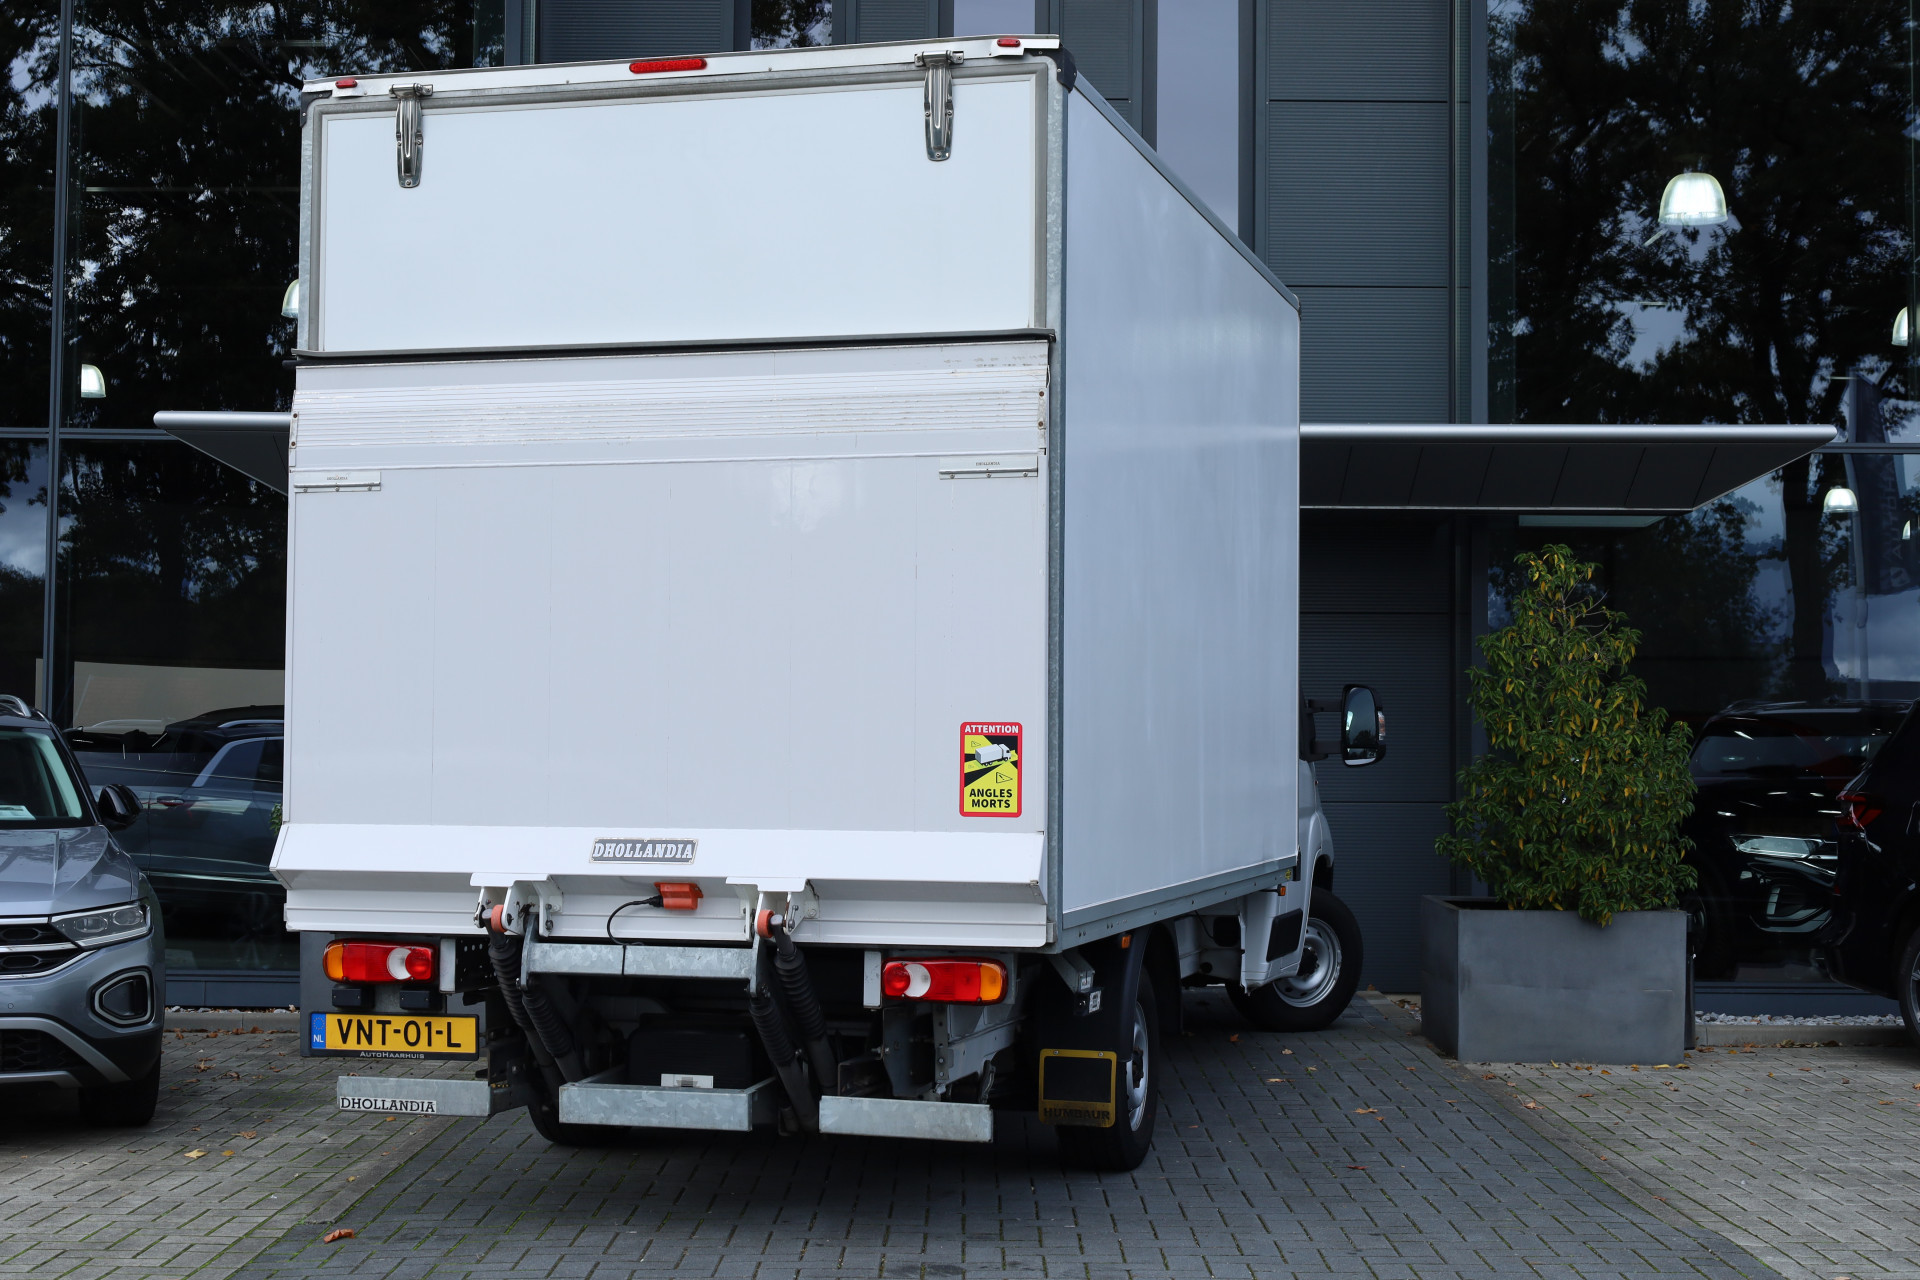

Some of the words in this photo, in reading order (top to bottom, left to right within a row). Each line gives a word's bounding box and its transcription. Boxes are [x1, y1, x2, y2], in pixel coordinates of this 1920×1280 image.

[964, 725, 1019, 734] ATTENTION
[969, 788, 1013, 798] ANGLES
[971, 799, 1011, 808] MORTS
[592, 843, 693, 859] DHOLLANDIA
[313, 1034, 324, 1043] NL
[337, 1018, 461, 1048] VNT-01-L
[340, 1097, 436, 1113] DHOLLANDIA
[1043, 1107, 1110, 1120] HUMBAUR
